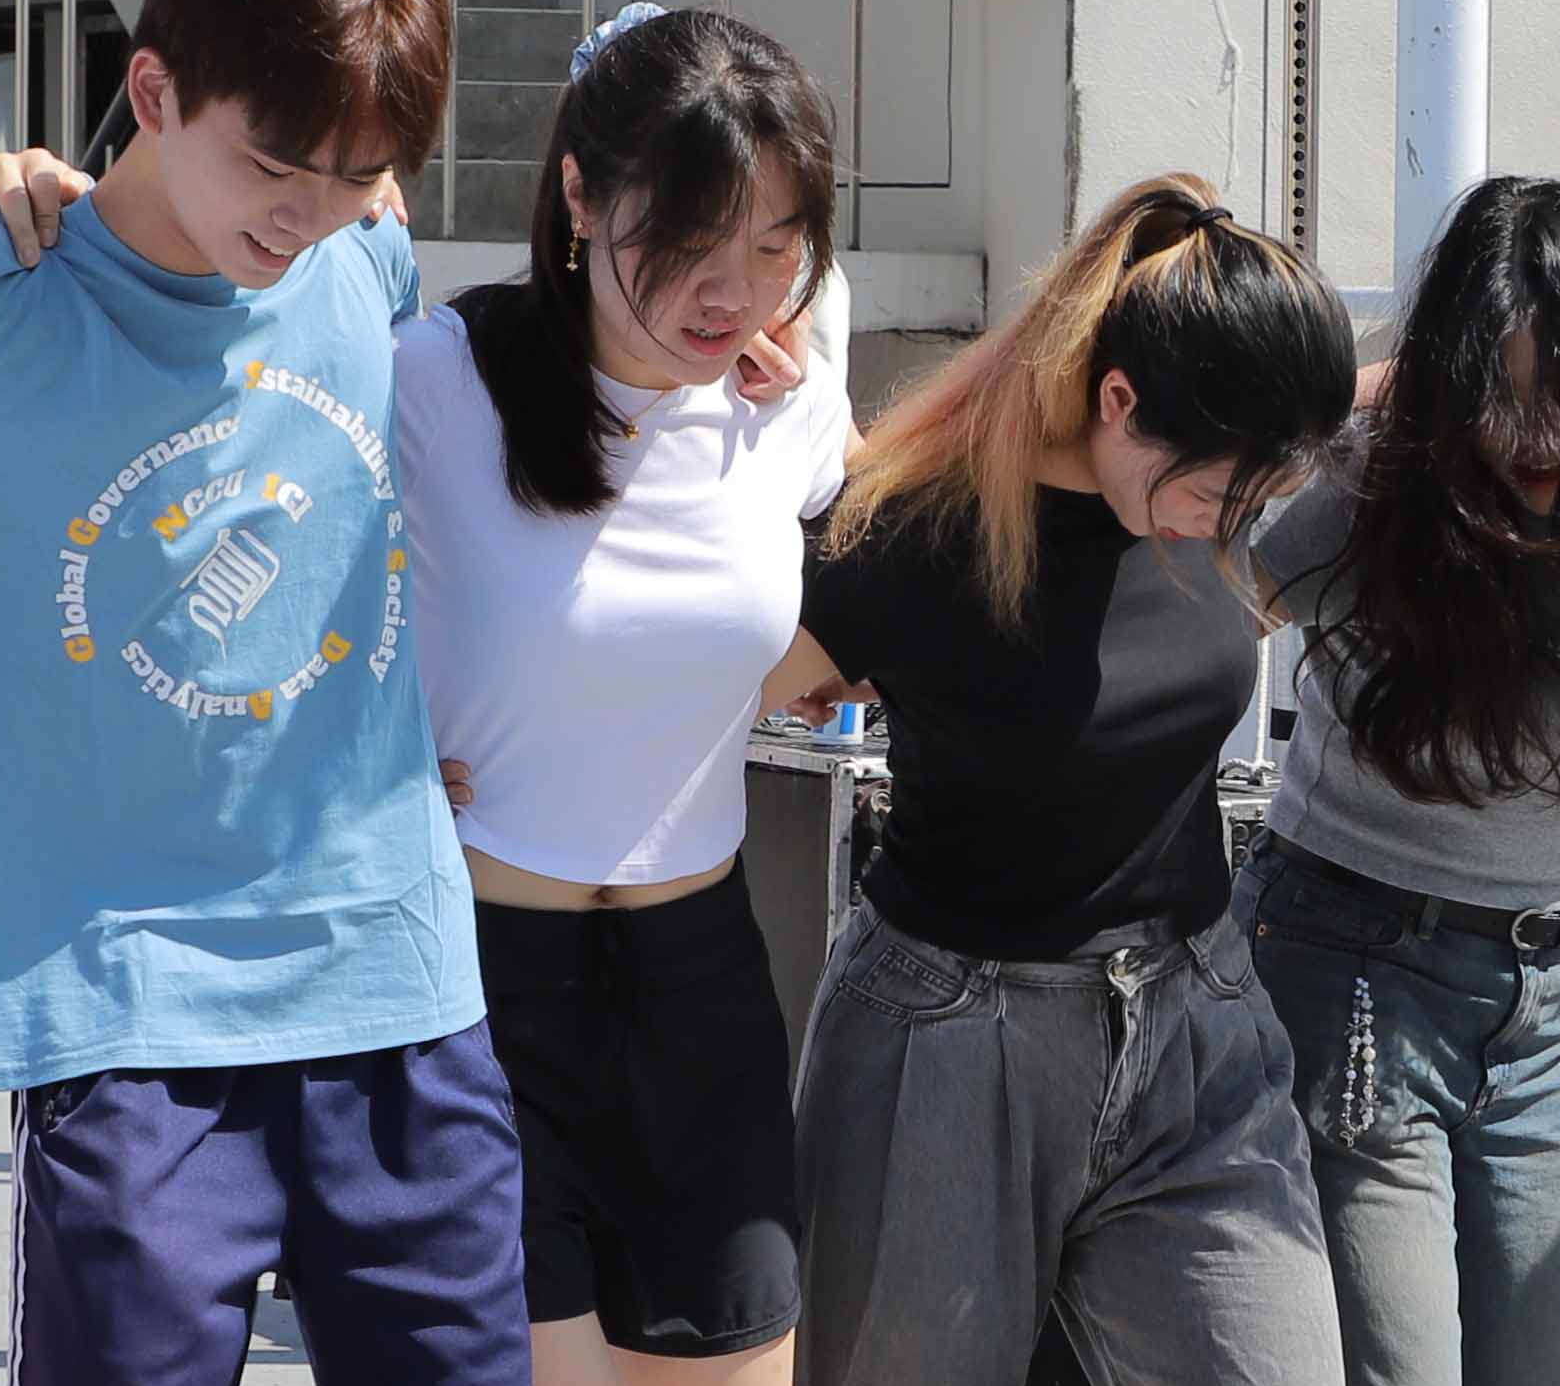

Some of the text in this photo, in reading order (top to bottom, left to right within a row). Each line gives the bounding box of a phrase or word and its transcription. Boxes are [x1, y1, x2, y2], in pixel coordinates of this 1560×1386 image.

[67, 415, 241, 546] Governanc
[152, 469, 247, 543] NCCU
[385, 509, 404, 541] &
[56, 549, 95, 663] Global
[368, 548, 408, 685] Society
[119, 630, 353, 721] Data Analytics
